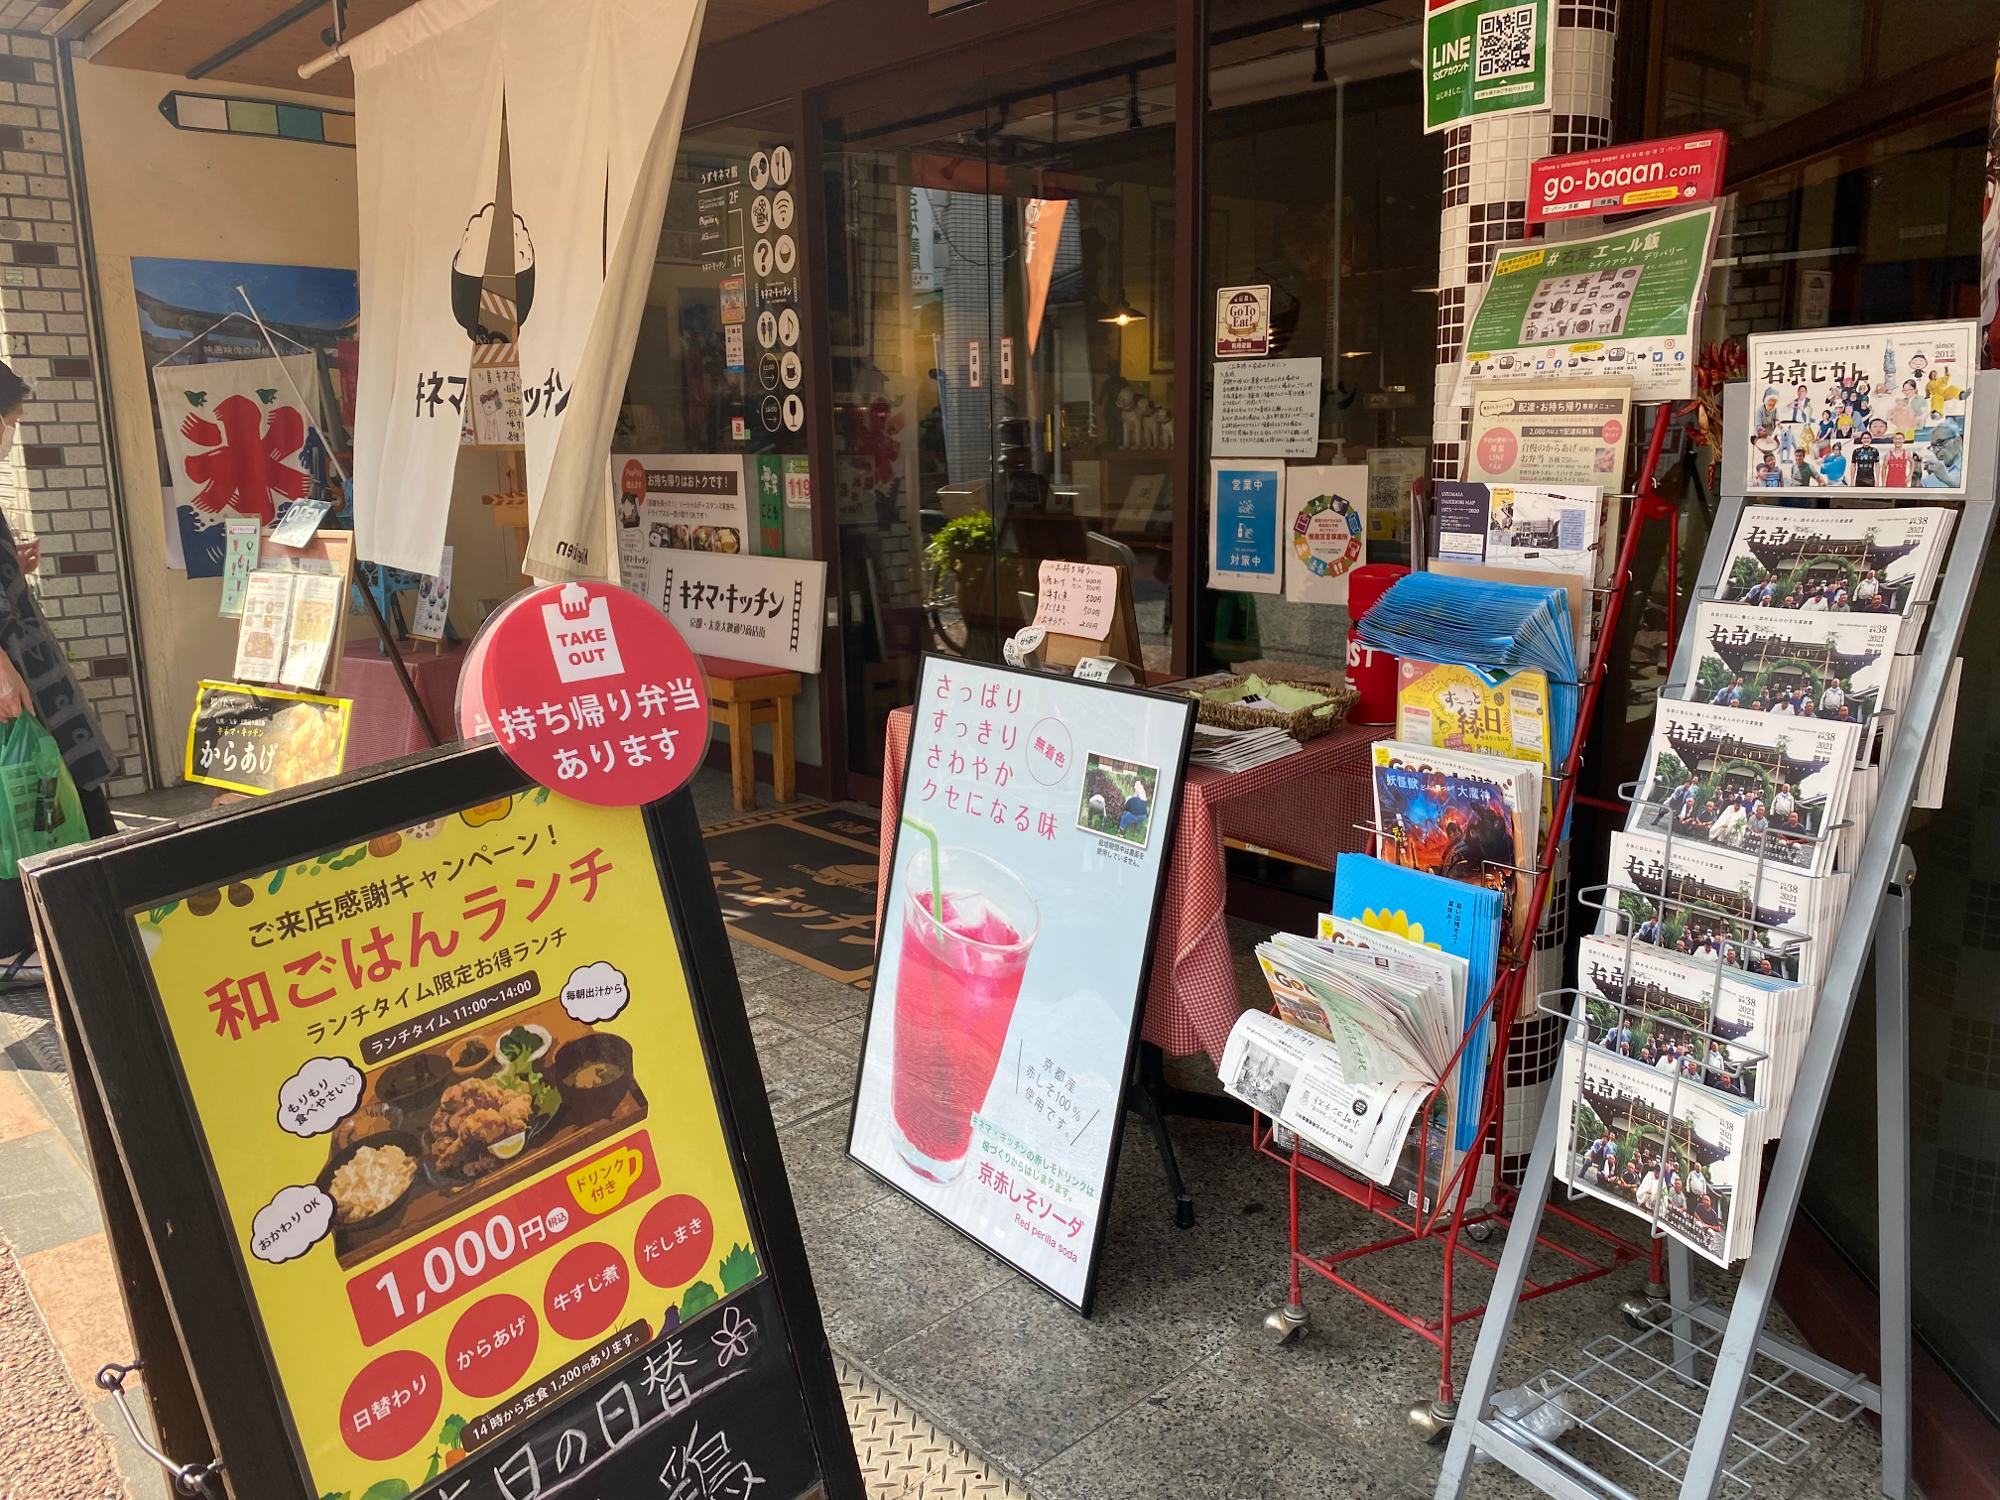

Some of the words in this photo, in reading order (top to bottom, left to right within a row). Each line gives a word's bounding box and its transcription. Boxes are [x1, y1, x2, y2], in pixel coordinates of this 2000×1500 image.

[1432, 36, 1471, 69] LINE
[1432, 61, 1470, 82] 公式アカウント
[1543, 158, 1702, 201] go-baaan.com
[729, 190, 739, 204] 2F
[732, 255, 742, 268] 1F
[1587, 256, 1635, 270] テイクアウト
[1644, 247, 1683, 261] デリバリー
[760, 287, 792, 299] キネマ・キッチン
[1232, 316, 1253, 328] Eat!
[1934, 349, 1956, 358] 2012
[1761, 359, 1869, 386] 右京じかん
[1521, 455, 1544, 463] お弁当
[1522, 443, 1578, 453] 自慢のからあげ
[647, 472, 729, 489] お持ち帰りはおトクです!
[1231, 479, 1263, 491] 営業中
[1907, 526, 1925, 534] 2021
[1230, 554, 1261, 567] 対策中
[680, 580, 785, 618] キネマ・キッチン
[556, 628, 607, 648] TAKE
[1867, 634, 1885, 643] 2021
[568, 648, 606, 666] OUT
[498, 677, 700, 744] 持ち帰り弁当
[936, 674, 1022, 714] さっぱり
[216, 727, 264, 738] キネマ・キッチン
[932, 709, 1018, 751] すっきり
[1457, 706, 1502, 740] 縁日
[200, 739, 278, 775] からあげ
[553, 727, 680, 780] あります
[1033, 735, 1066, 768] 無着色
[1816, 741, 1833, 750] 2021
[927, 744, 1014, 787] さわやか
[921, 778, 1059, 841] クセになる味
[1458, 785, 1491, 801] 大魔神
[1096, 847, 1141, 869] 使用していません。
[1097, 838, 1146, 860] 栽培期間中は農薬を
[247, 823, 560, 950] ご来店感謝キャンペーン!
[1779, 892, 1797, 902] 2021
[206, 846, 616, 1042] 和ごはんランチ
[305, 926, 569, 1046] ランチタイム限定お得ランチ
[565, 982, 624, 1003] 毎朝出汁から
[1738, 1004, 1756, 1016] 2021
[370, 1014, 451, 1056] ランチタイム
[1042, 1056, 1077, 1093] 京都産
[288, 1077, 329, 1115] もりもり
[1024, 1086, 1071, 1139] 使用です。
[1311, 1095, 1361, 1129] 小町コンテスト
[1719, 1128, 1733, 1141] 2021
[972, 1114, 1095, 1198] キネマ・キッチンの赤しそドリンクは
[981, 1139, 1073, 1203] 畑づくりからはじまります。
[575, 1158, 625, 1193] ドリンク
[591, 1180, 617, 1204] 付き
[977, 1162, 1085, 1239] 京赤しそソーダ
[258, 1214, 303, 1252] おかわり
[303, 1197, 321, 1215] OK
[547, 1212, 568, 1227] 税込
[642, 1216, 704, 1264] だしまき
[1014, 1212, 1030, 1233] Red
[1031, 1225, 1057, 1248] perilla
[1058, 1242, 1078, 1263] soda
[552, 1262, 621, 1312] 牛すじ煮
[456, 1315, 527, 1371] からあげ
[351, 1374, 429, 1433] 日替わり
